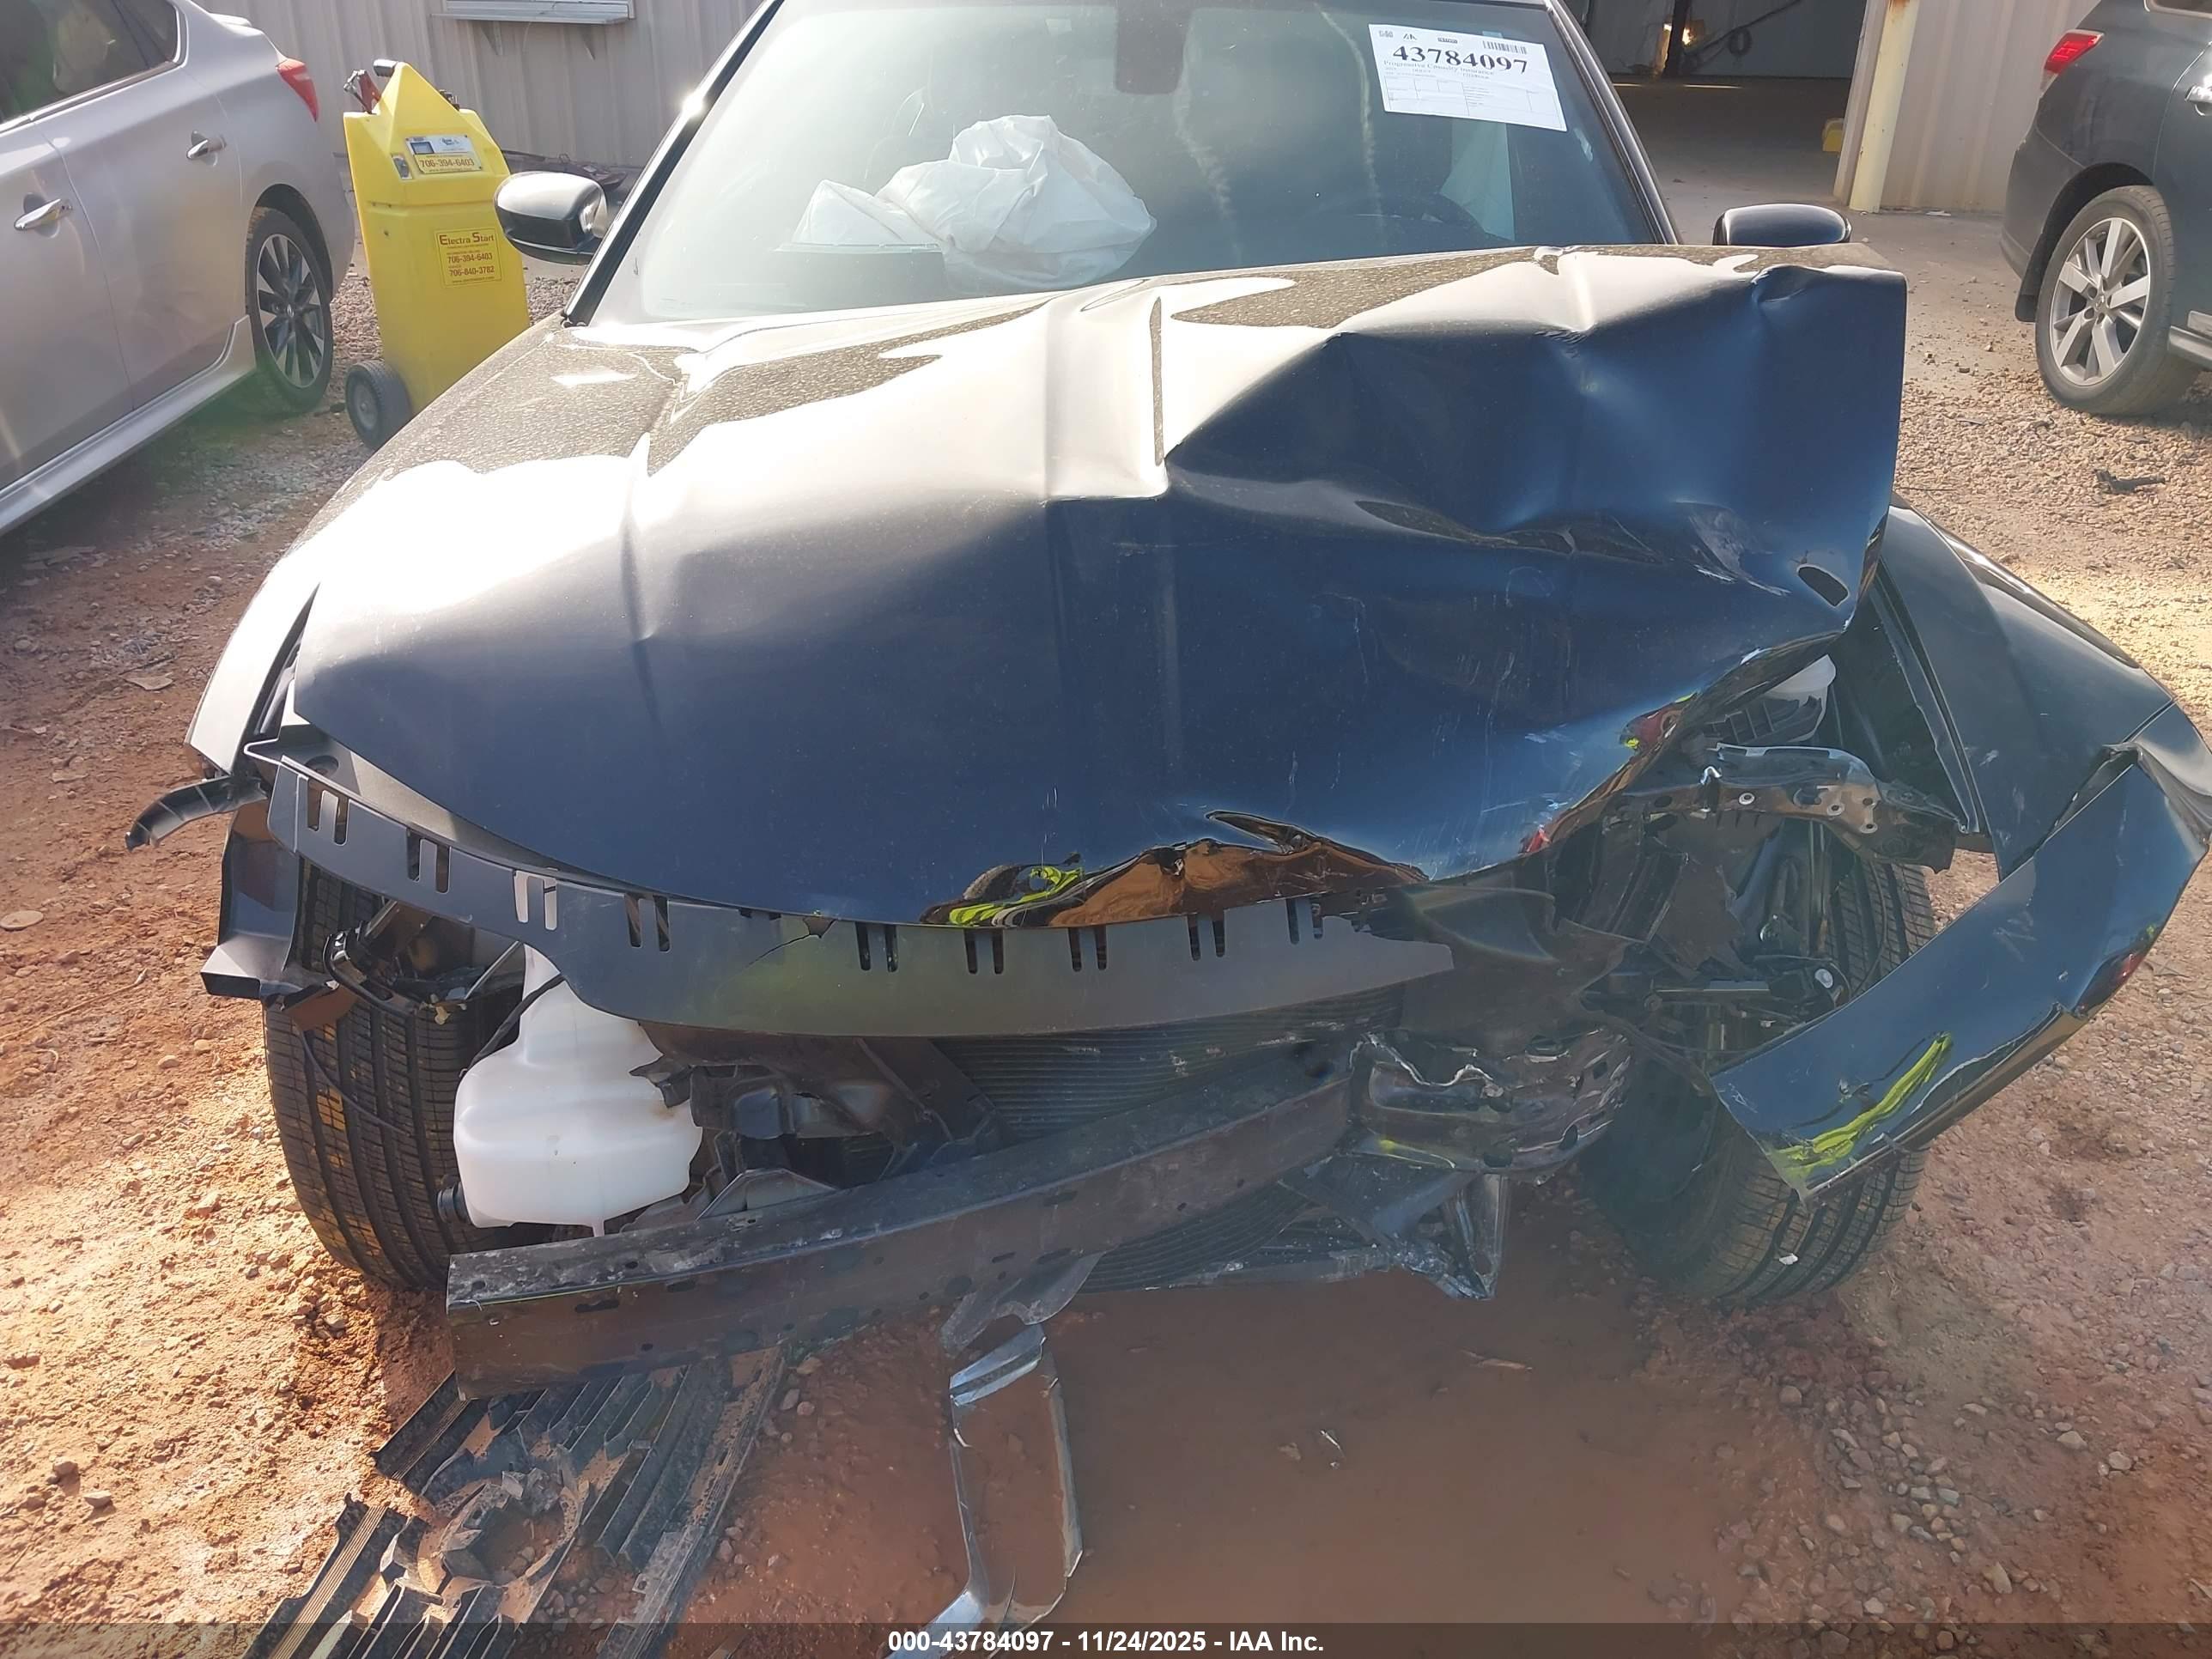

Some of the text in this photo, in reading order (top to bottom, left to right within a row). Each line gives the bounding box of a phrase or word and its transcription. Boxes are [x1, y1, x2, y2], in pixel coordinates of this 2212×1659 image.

[1392, 46, 1528, 75] 43784097
[419, 157, 475, 168] 706-394-6403
[439, 232, 495, 246] Electra Start
